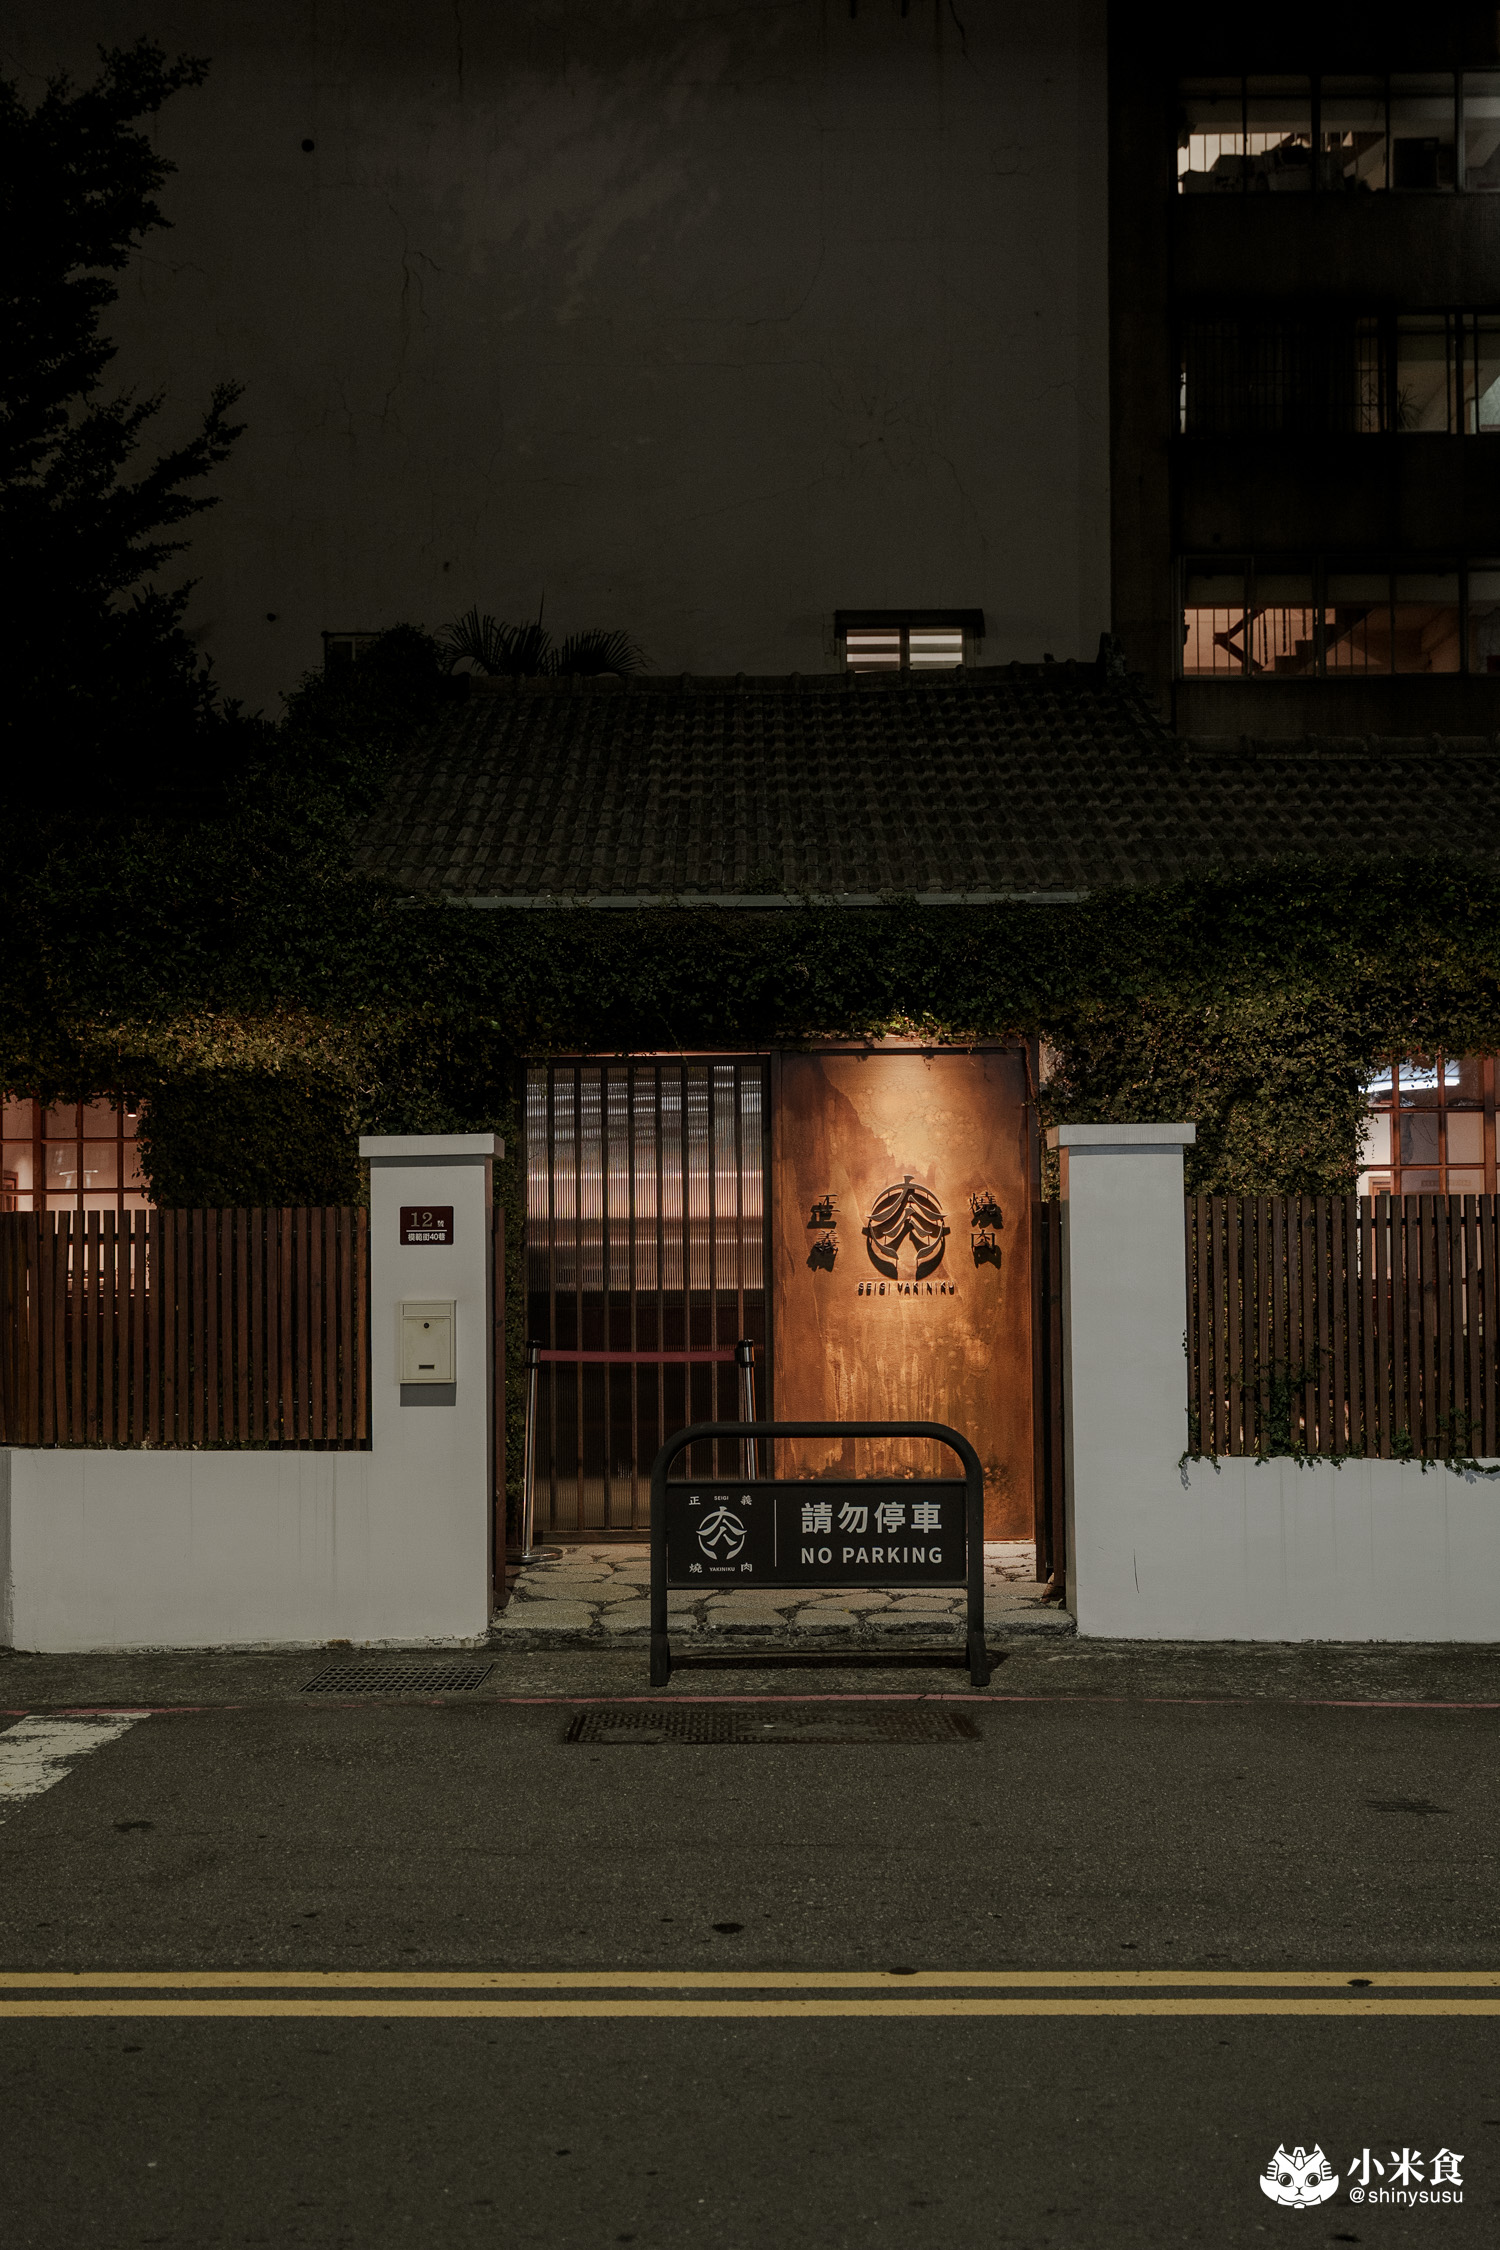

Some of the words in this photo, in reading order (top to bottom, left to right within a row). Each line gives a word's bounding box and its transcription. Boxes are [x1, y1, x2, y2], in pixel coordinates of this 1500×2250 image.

[968, 1191, 997, 1253] 燒肉
[858, 1281, 891, 1295] SEIGI
[897, 1281, 956, 1295] YAKINIKU
[801, 1502, 942, 1534] 請勿停車
[801, 1547, 834, 1565] NO
[842, 1546, 943, 1565] PARKING
